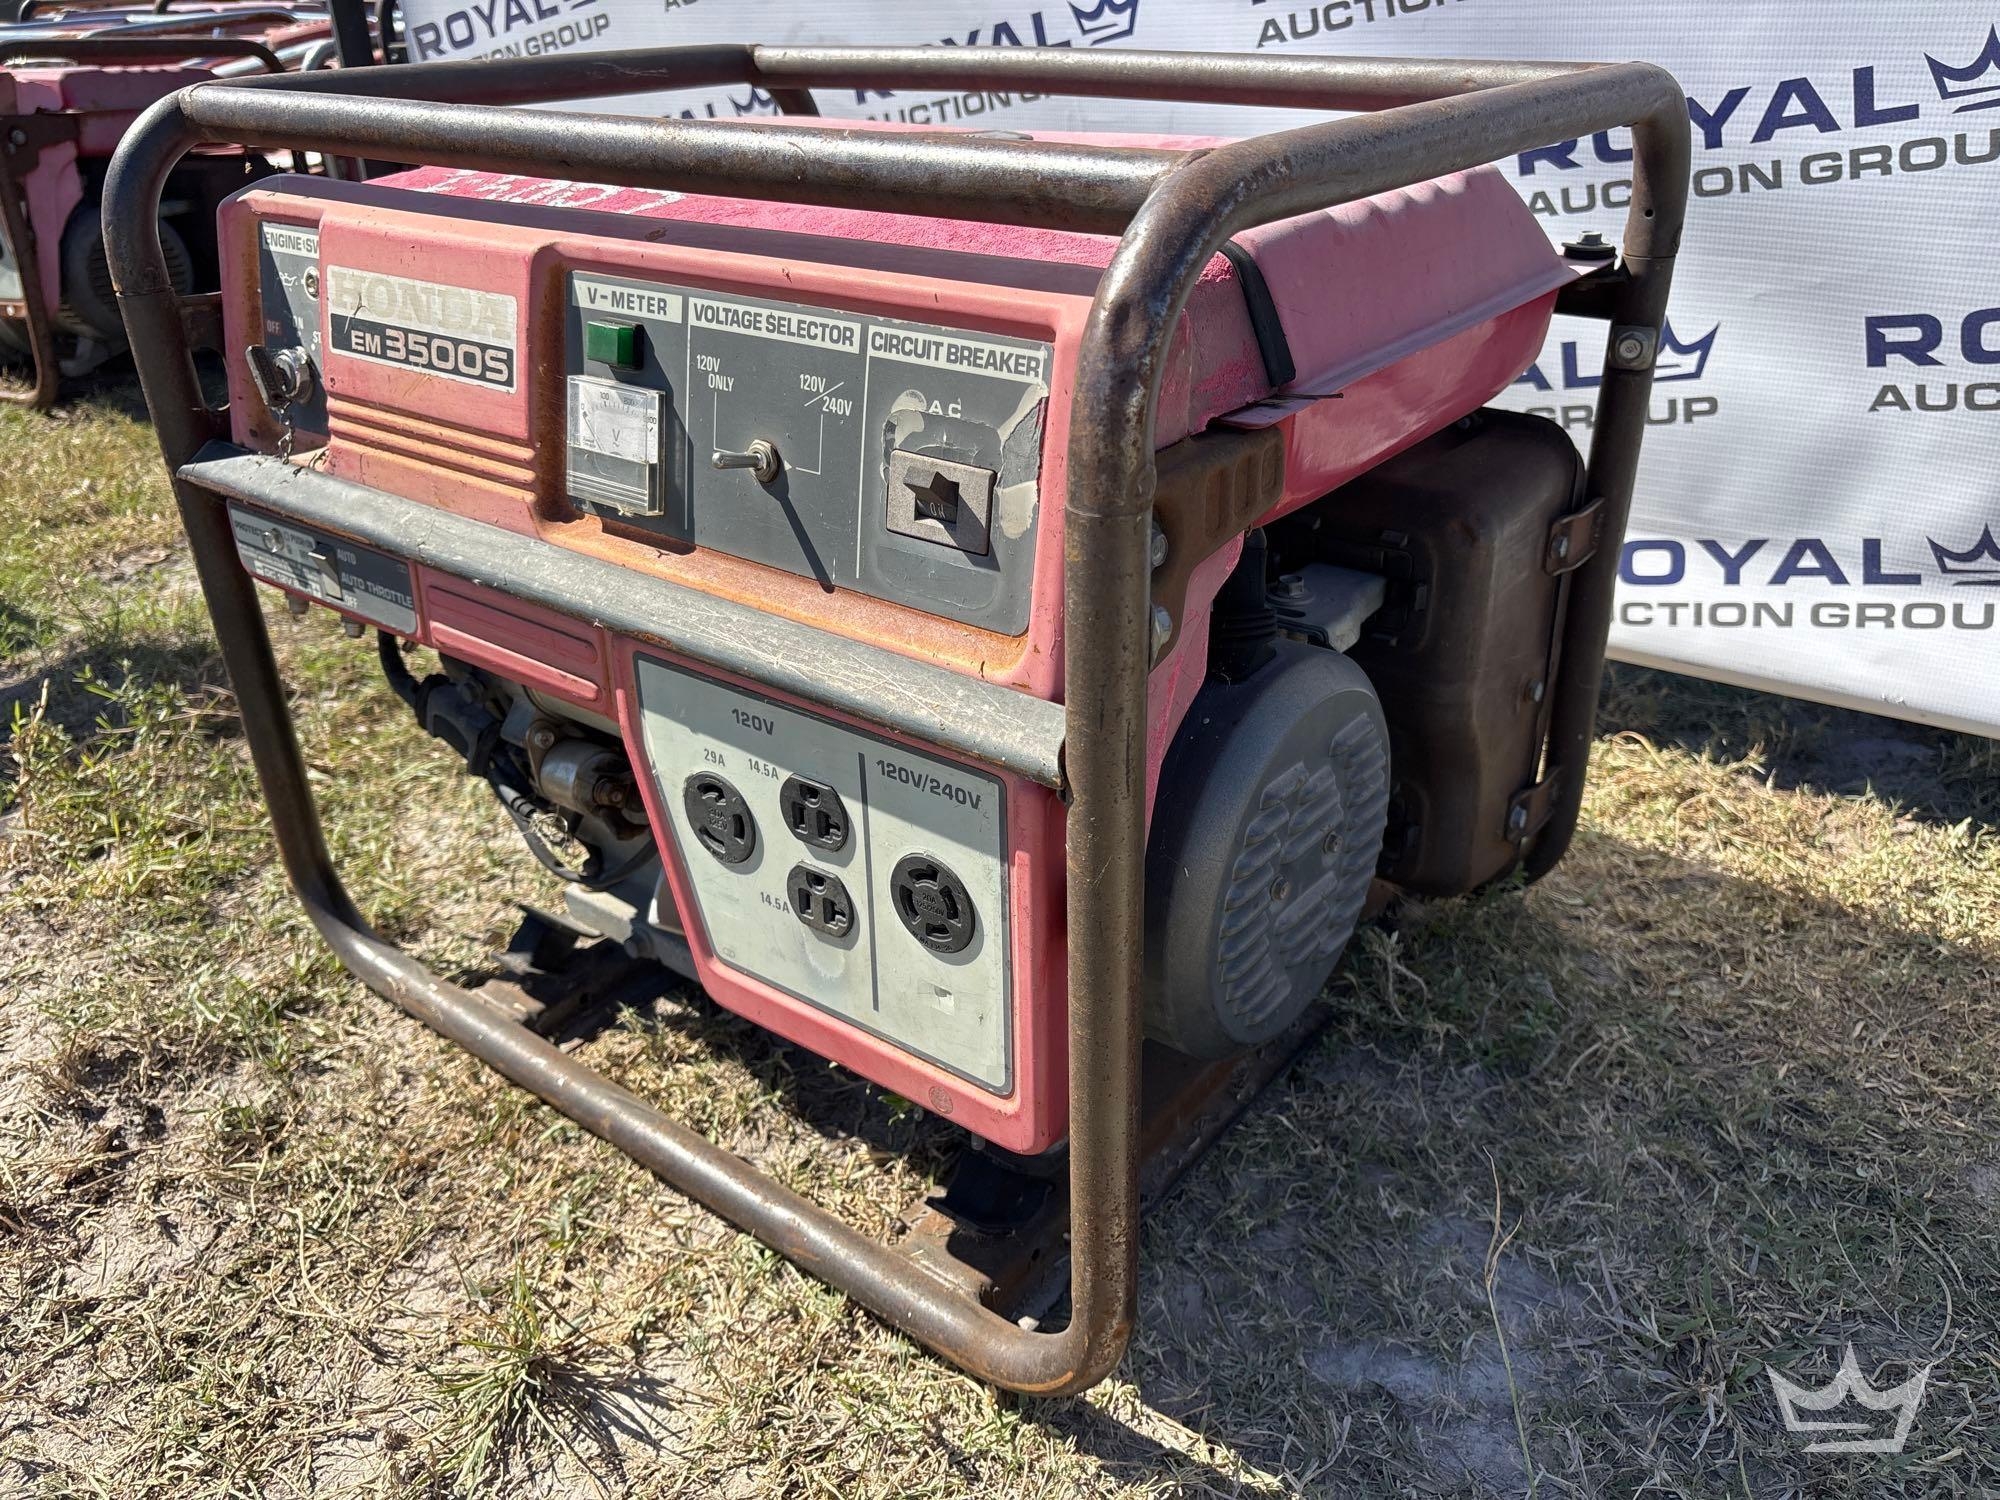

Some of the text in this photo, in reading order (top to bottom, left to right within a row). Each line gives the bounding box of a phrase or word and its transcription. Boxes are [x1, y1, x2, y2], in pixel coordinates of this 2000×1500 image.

[525, 13, 610, 57] GROUP
[1256, 0, 1466, 49] AUCTIO
[1529, 159, 1783, 217] AUCON
[264, 230, 302, 251] ENGINE
[331, 272, 515, 341] HONDA
[587, 287, 668, 317] V-METER
[266, 320, 281, 335] OFF
[694, 305, 855, 348] VOLTAGE SELECTOR
[696, 354, 721, 373] 120V
[871, 331, 1041, 378] CIRCUIT BREAKER
[708, 372, 735, 392] ONLY
[822, 395, 853, 418] 240V
[337, 549, 357, 565] AUTO
[1617, 539, 1922, 585] OYAL
[341, 572, 365, 590] AUTO
[366, 580, 414, 608] THROTTLE
[1620, 603, 1793, 627] CTION
[731, 708, 774, 735] 120V
[703, 748, 779, 780] 29A 14.5A
[877, 760, 982, 810] 120V/240V
[760, 891, 790, 914] 14.5A
